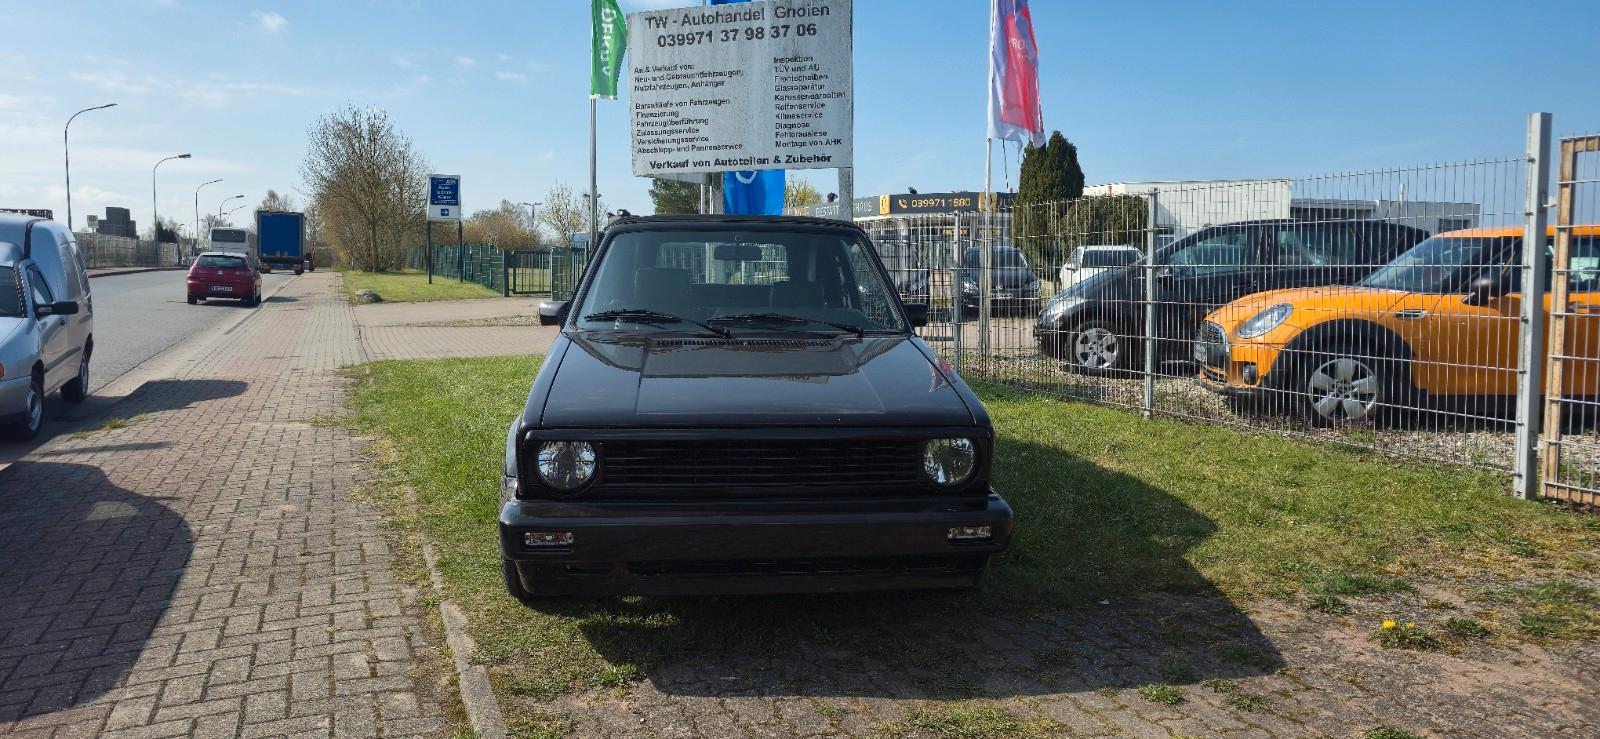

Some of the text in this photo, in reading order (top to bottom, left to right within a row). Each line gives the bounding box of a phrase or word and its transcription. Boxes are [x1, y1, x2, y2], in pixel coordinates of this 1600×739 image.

[645, 16, 668, 29] TW
[681, 8, 764, 27] Autohandel
[774, 5, 830, 19] Gnoien
[658, 23, 817, 47] 039971 37 98 37 06
[774, 56, 813, 64] Inspektion
[651, 64, 678, 72] Verkauf
[774, 64, 790, 72] TÜV
[634, 75, 650, 83] Neu-
[774, 74, 828, 82] Frontscheiben
[774, 84, 825, 92] Glasreparatur
[775, 102, 825, 110] Reifenservice
[636, 111, 679, 119] Finanzierung
[636, 118, 709, 127] Fahrzeugüberführung
[775, 122, 810, 130] Diagnose
[637, 127, 700, 136] Zulassungsservice
[637, 136, 709, 145] Versicherungsservice
[775, 140, 806, 148] Montage
[650, 159, 689, 169] Verkauf
[714, 157, 769, 166] Autoteilen
[773, 155, 781, 164] &
[784, 153, 832, 164] Zubehör
[911, 198, 945, 208] 039971
